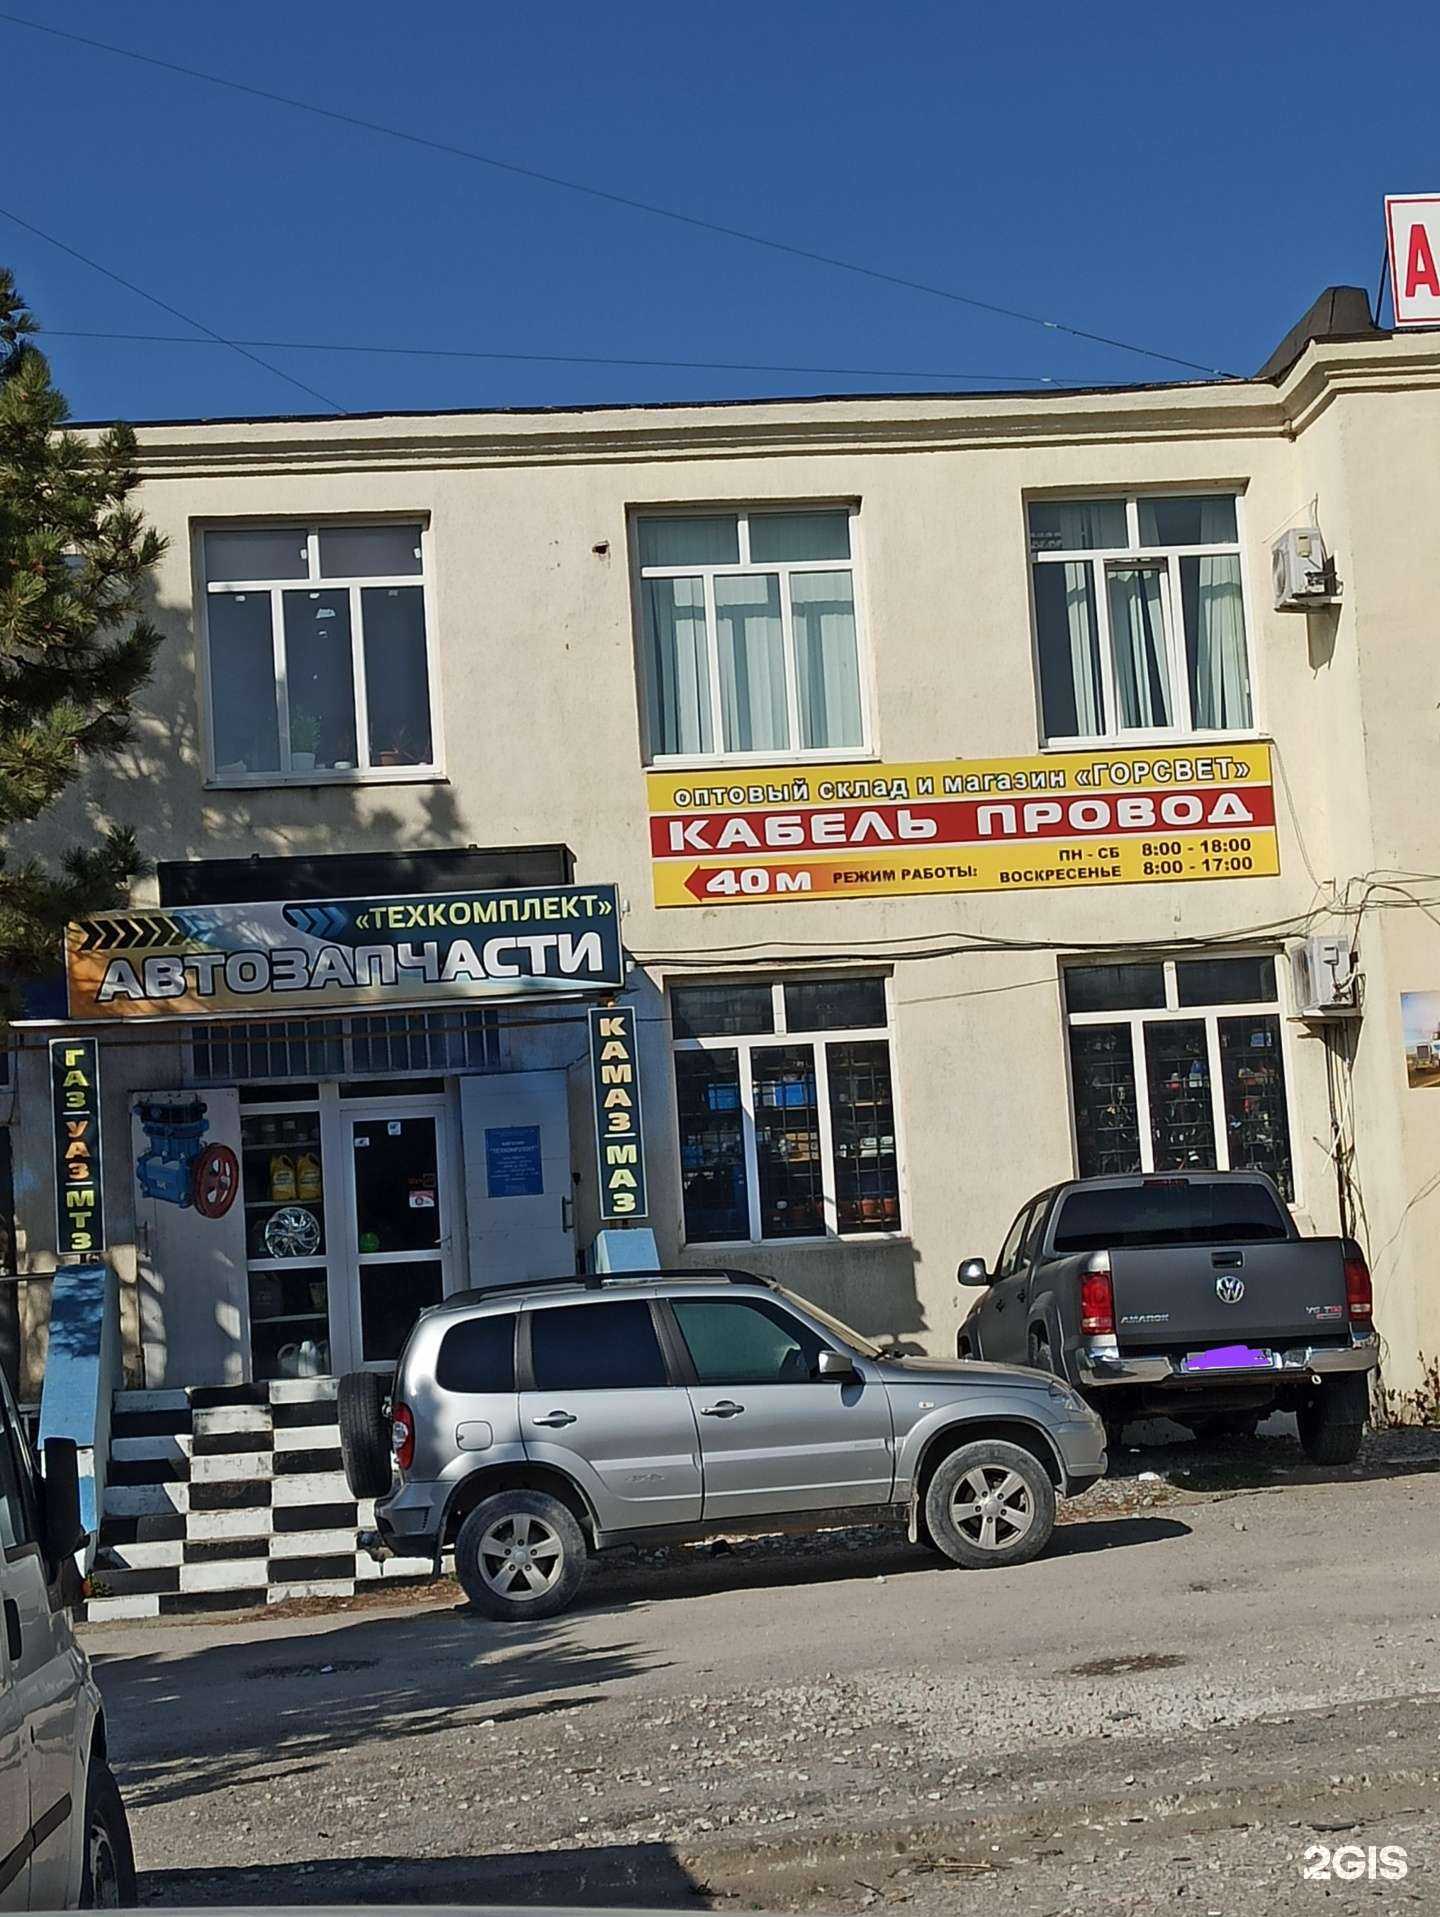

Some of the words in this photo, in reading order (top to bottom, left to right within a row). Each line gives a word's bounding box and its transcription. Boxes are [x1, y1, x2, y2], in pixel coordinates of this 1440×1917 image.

[674, 778, 809, 807] оптовый
[818, 777, 909, 800] склад
[917, 775, 935, 795] и
[943, 769, 1066, 794] магазин
[1075, 757, 1250, 786] «ГОРСВЕТ»
[668, 809, 938, 851] КАБЕЛЬ
[976, 792, 1253, 836] ПРОВОД
[1058, 849, 1083, 862] ПН
[1097, 846, 1120, 859] СБ
[1141, 841, 1181, 857] 8:00
[1200, 837, 1251, 853] 18:00
[832, 869, 896, 884] РЕЖИМ
[901, 865, 978, 881] РАБОТЫ:
[999, 865, 1122, 883] ВОСКРЕСЕНЬЕ
[1143, 859, 1183, 875] 8:00
[1201, 856, 1253, 872] 17:00
[355, 894, 613, 930] «ТЕХКОМПЛЕКТ»
[97, 930, 604, 1001] АВТОЗАПЧАСТИ
[63, 1049, 90, 1108] ГАЗ
[599, 1016, 632, 1132] КАМАЗ
[65, 1120, 91, 1180] УАЗ
[606, 1144, 638, 1213] МАЗ
[66, 1190, 95, 1250] МТЗ
